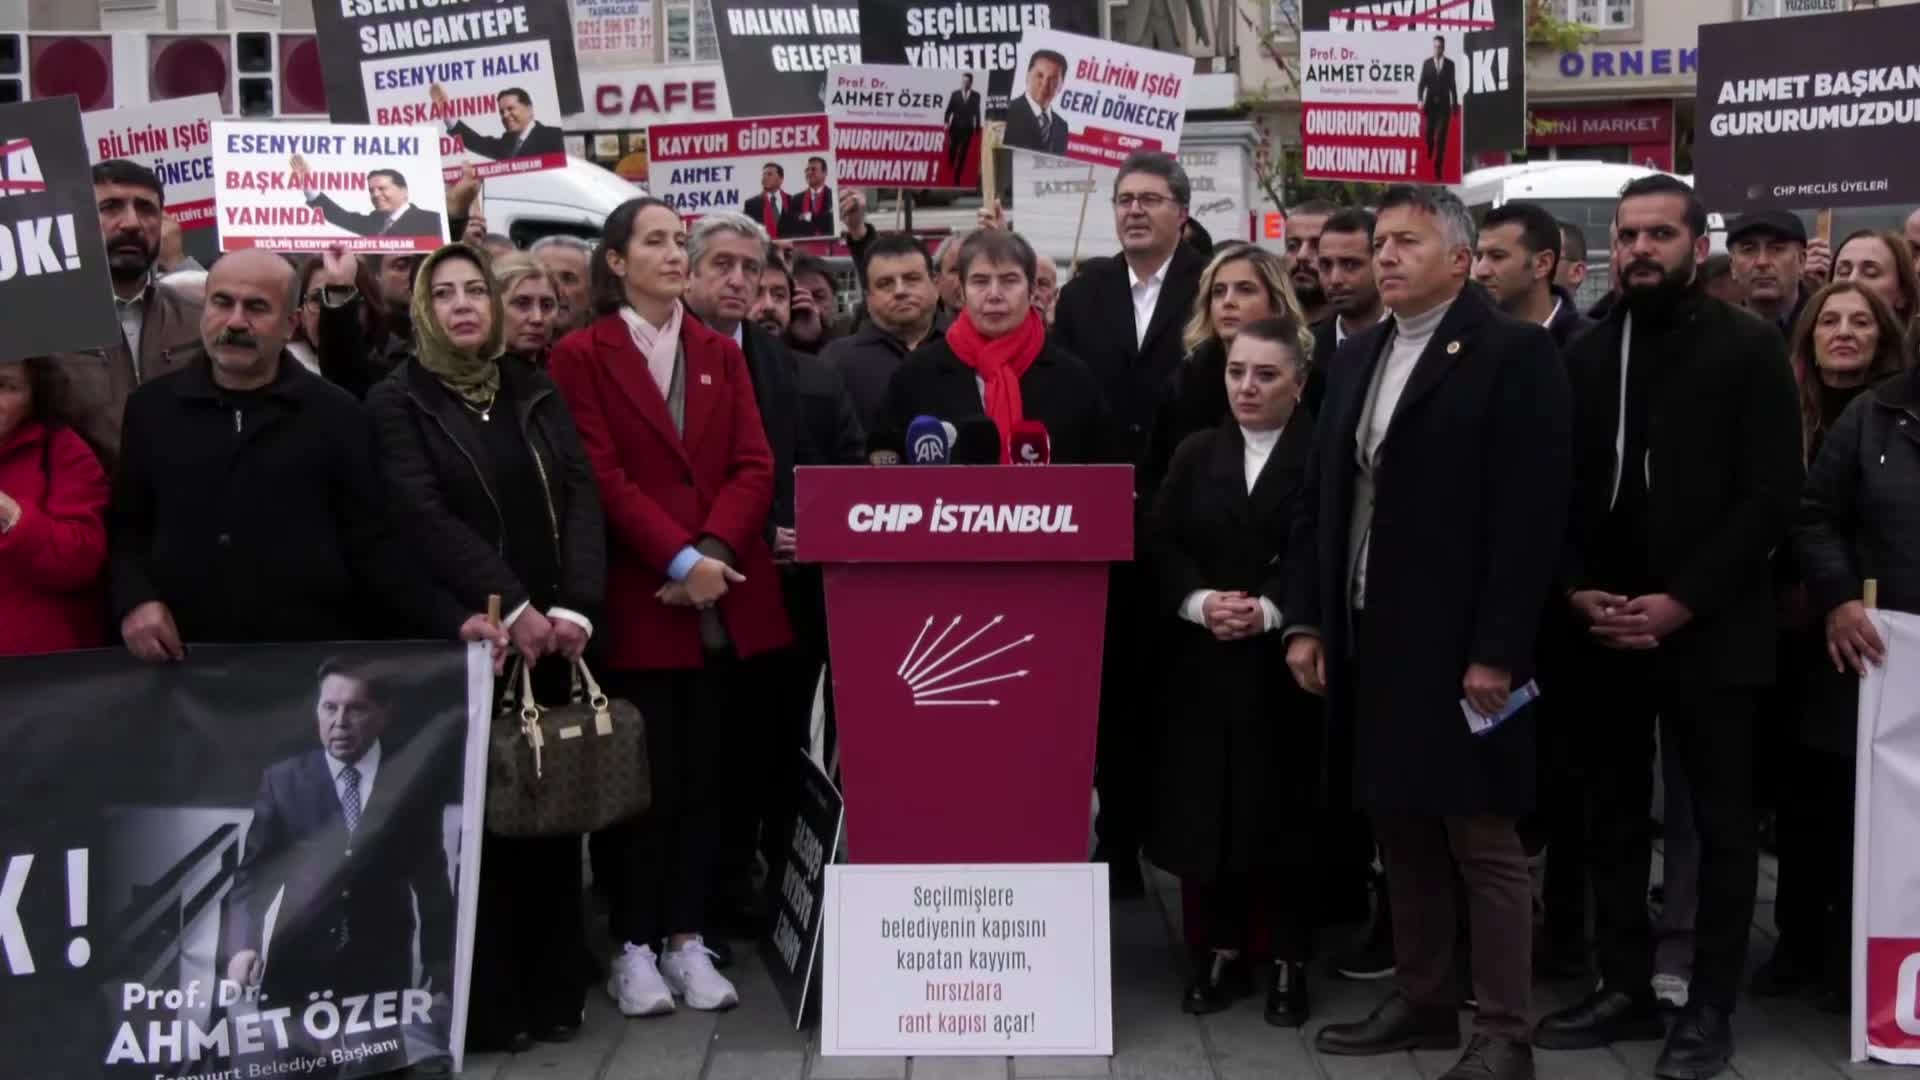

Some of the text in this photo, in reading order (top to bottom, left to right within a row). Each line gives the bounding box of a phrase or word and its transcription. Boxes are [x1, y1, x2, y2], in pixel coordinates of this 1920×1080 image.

[359, 6, 529, 54] SANCAKTEPE
[726, 8, 810, 35] HALKIN
[906, 4, 1050, 39] SEÇİLENLER
[904, 42, 1020, 71] YÖNETEC
[1309, 47, 1358, 61] Prof. Dr.
[374, 52, 540, 90] ESENYURT HALKI
[838, 76, 888, 89] Prof. Dr.
[1075, 56, 1181, 99] BİLİMİN IŞIĞI
[1306, 59, 1415, 82] AHMET ÖZER
[1717, 65, 1920, 104] AHMET BAŞKAN
[376, 94, 497, 127] BAŞKANININ
[595, 80, 717, 116] CAFE
[832, 88, 943, 108] AHMET ÖZER
[1060, 90, 1180, 132] GERİ DÖNECEK
[1306, 109, 1421, 137] ONURUMUZDUR
[1582, 116, 1661, 133] MARKET
[98, 118, 211, 161] BİLİMİN IŞIĞ
[227, 134, 346, 155] ESENYURT
[353, 135, 420, 156] HALKI
[657, 124, 821, 157] KAYYUM GİDECEK
[831, 128, 945, 152] ONURUMUZDUR
[152, 157, 215, 186] ÖNECE
[837, 158, 929, 182] OKUNMAYIN
[1306, 146, 1406, 174] DOKUNMAYIN
[226, 170, 366, 195] BAŞKANININ
[671, 165, 735, 185] AHMET
[1773, 178, 1888, 197] CHP MECLİS ÜYELERİ
[664, 189, 740, 211] BAŞKAN
[225, 206, 326, 226] YANINDA
[916, 441, 944, 462] AA
[847, 497, 1079, 533] CHP İSTANBUL
[913, 885, 1014, 909] Seçilmişlere
[881, 917, 1047, 940] belediyenin kapısını
[896, 950, 1032, 973] kapatan kayyım,
[122, 978, 268, 1010] Prof. Dr.
[925, 980, 1002, 1001] hırsızlara
[105, 989, 433, 1064] AHMET ÖZER
[898, 1012, 1035, 1038] rant kapısı açar!
[249, 1055, 327, 1079] Belediye
[331, 1039, 399, 1064] Başkanı
